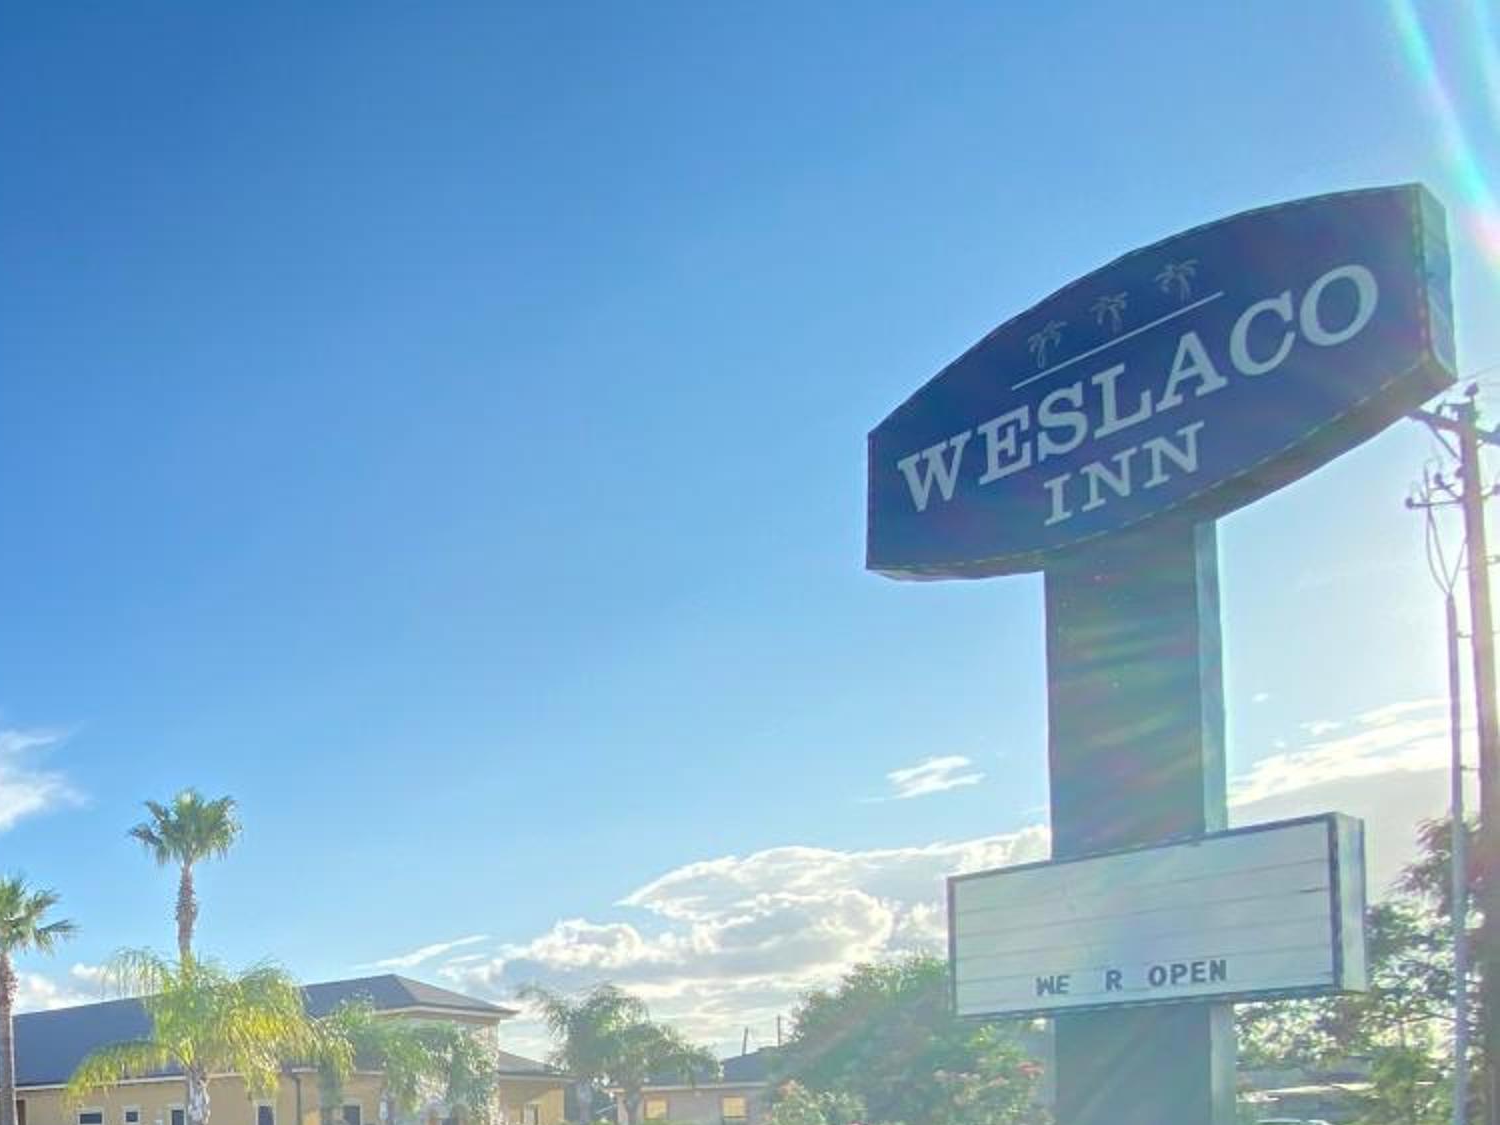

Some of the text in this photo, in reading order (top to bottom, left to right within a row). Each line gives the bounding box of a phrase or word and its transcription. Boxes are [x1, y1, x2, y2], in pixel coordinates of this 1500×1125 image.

[898, 264, 1379, 512] WESLACO
[1044, 421, 1204, 525] INN
[1036, 959, 1227, 996] WE R OPEN
